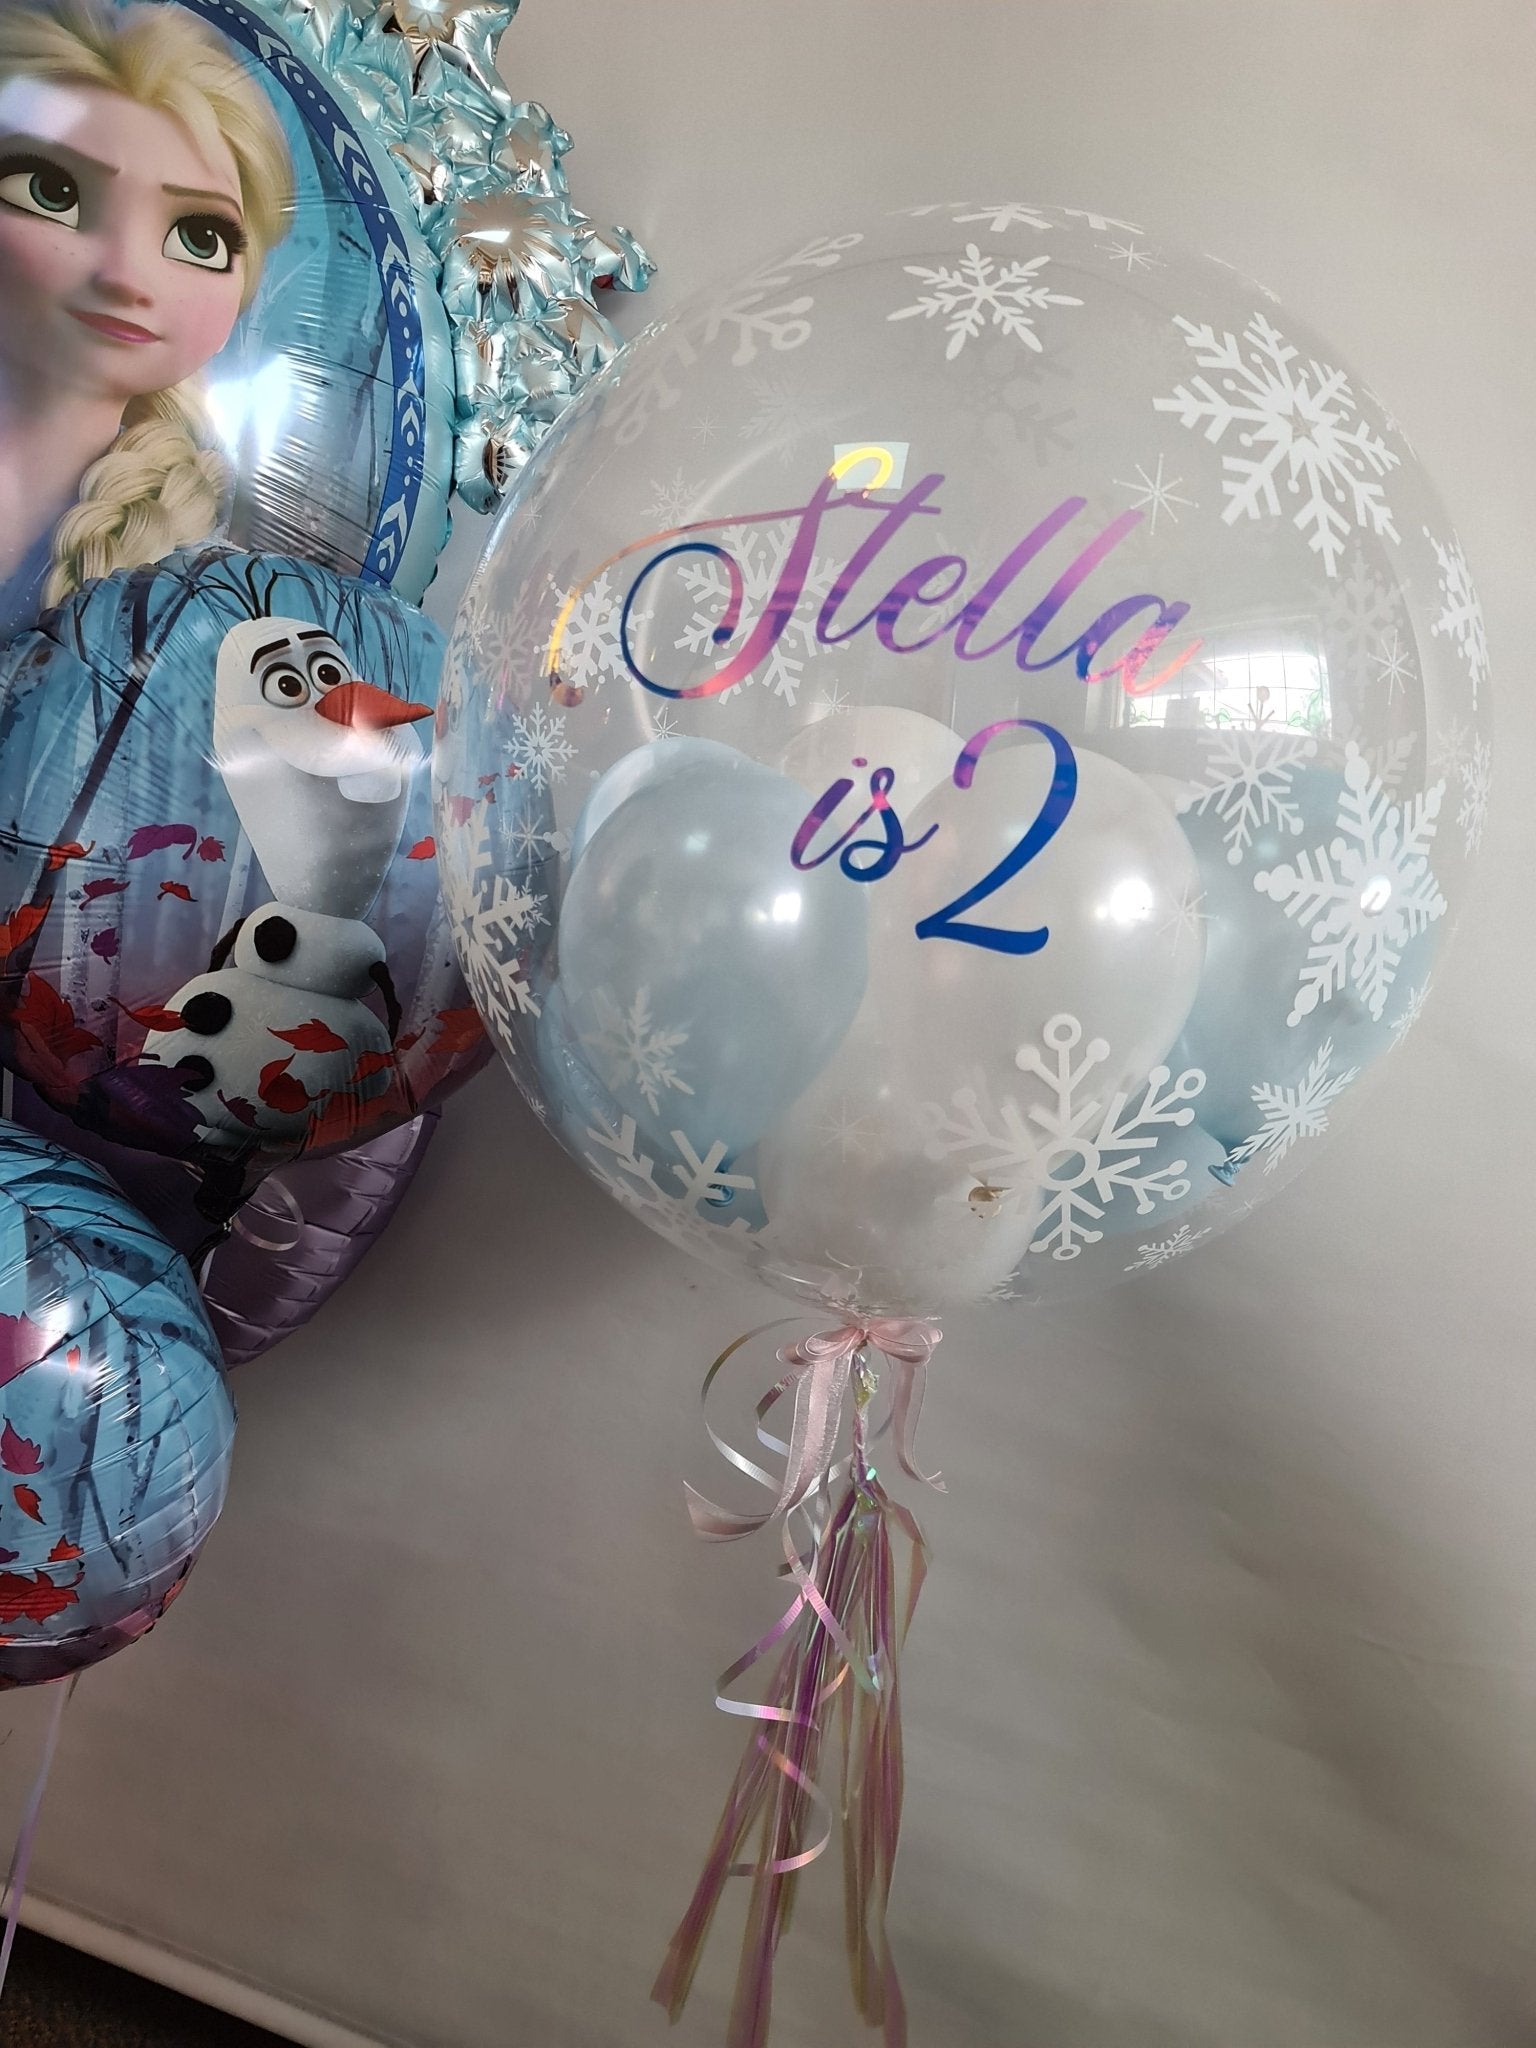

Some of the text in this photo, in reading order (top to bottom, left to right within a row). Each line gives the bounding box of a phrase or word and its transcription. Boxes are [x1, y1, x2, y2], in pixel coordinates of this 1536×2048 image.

[549, 446, 1203, 707] Stella
[790, 719, 1077, 955] is 2
